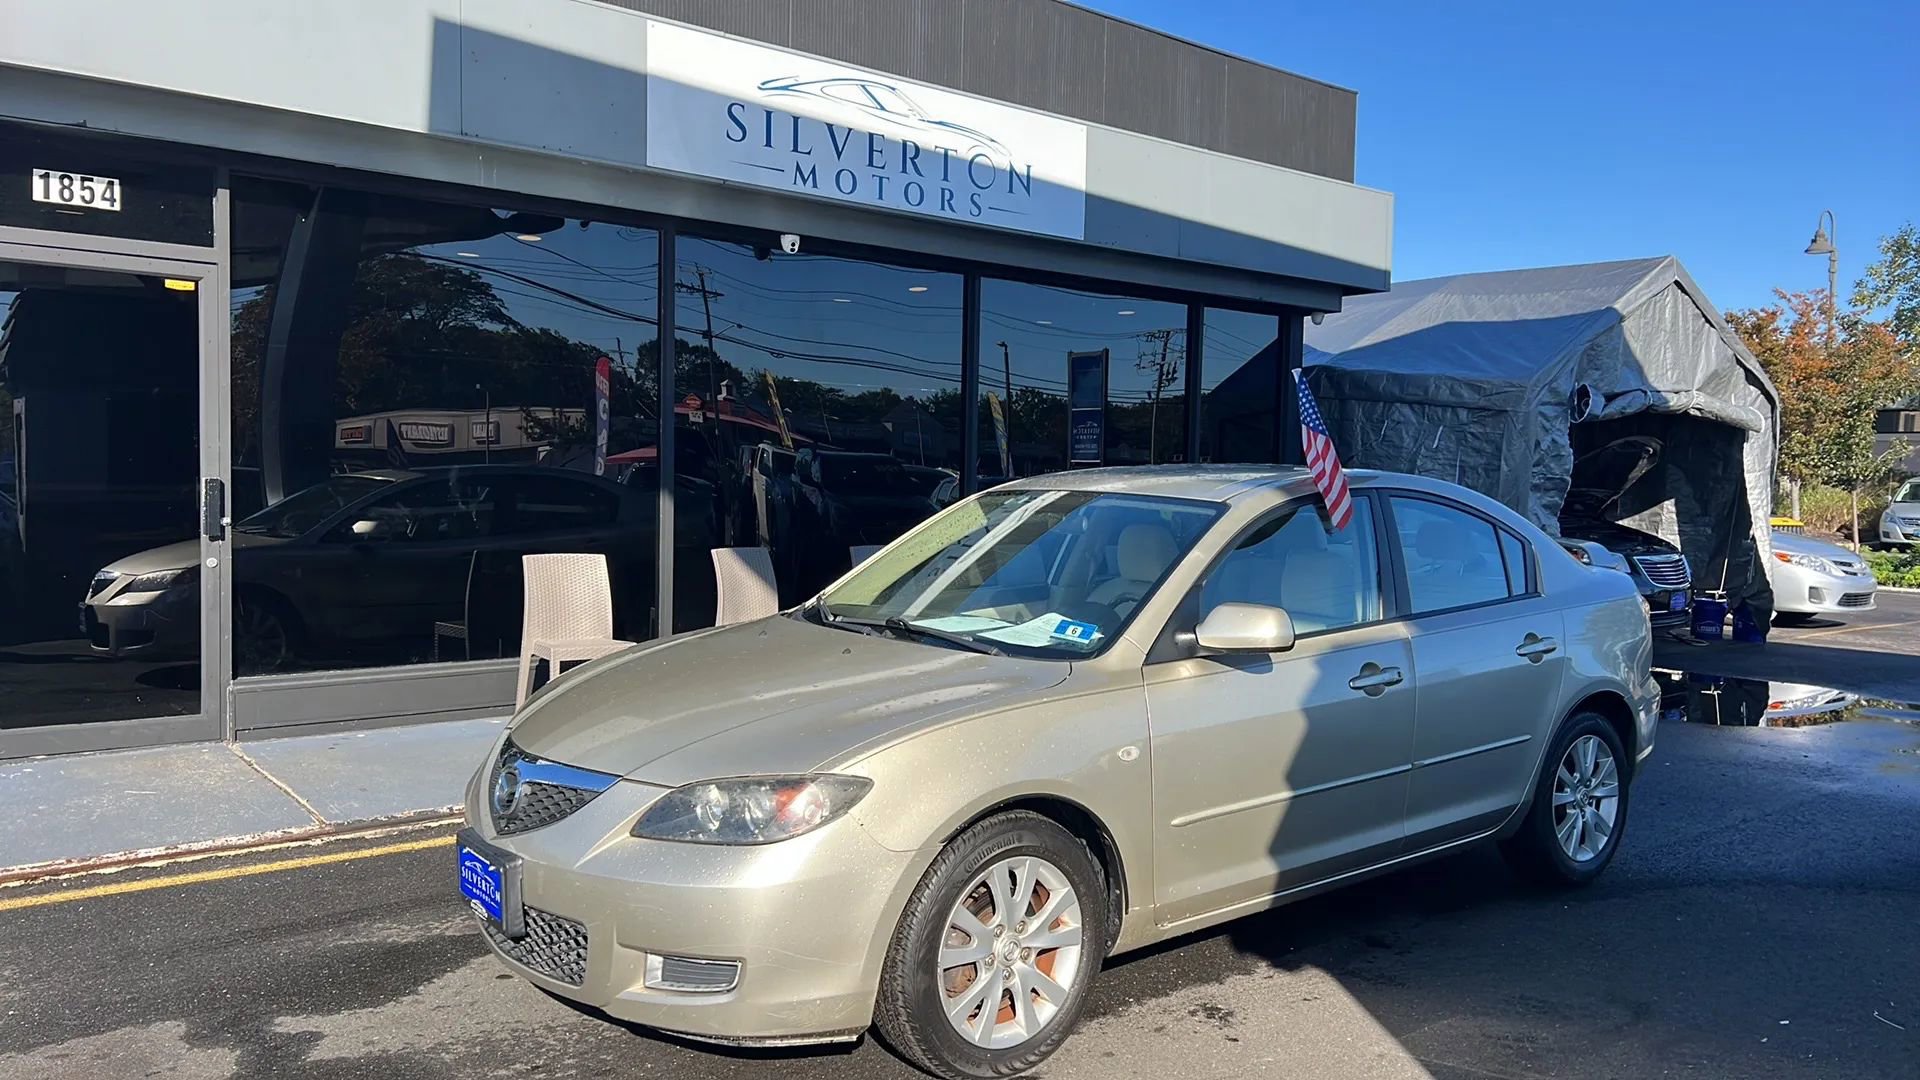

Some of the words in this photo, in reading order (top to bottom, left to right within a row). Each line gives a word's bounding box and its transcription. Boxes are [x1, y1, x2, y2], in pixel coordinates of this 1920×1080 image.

[726, 102, 1032, 198] SILVERTON
[38, 171, 117, 208] 1854
[792, 161, 982, 217] MOTORS
[1071, 627, 1078, 635] 6
[964, 833, 1017, 873] Continental
[461, 866, 501, 903] SILVERTON
